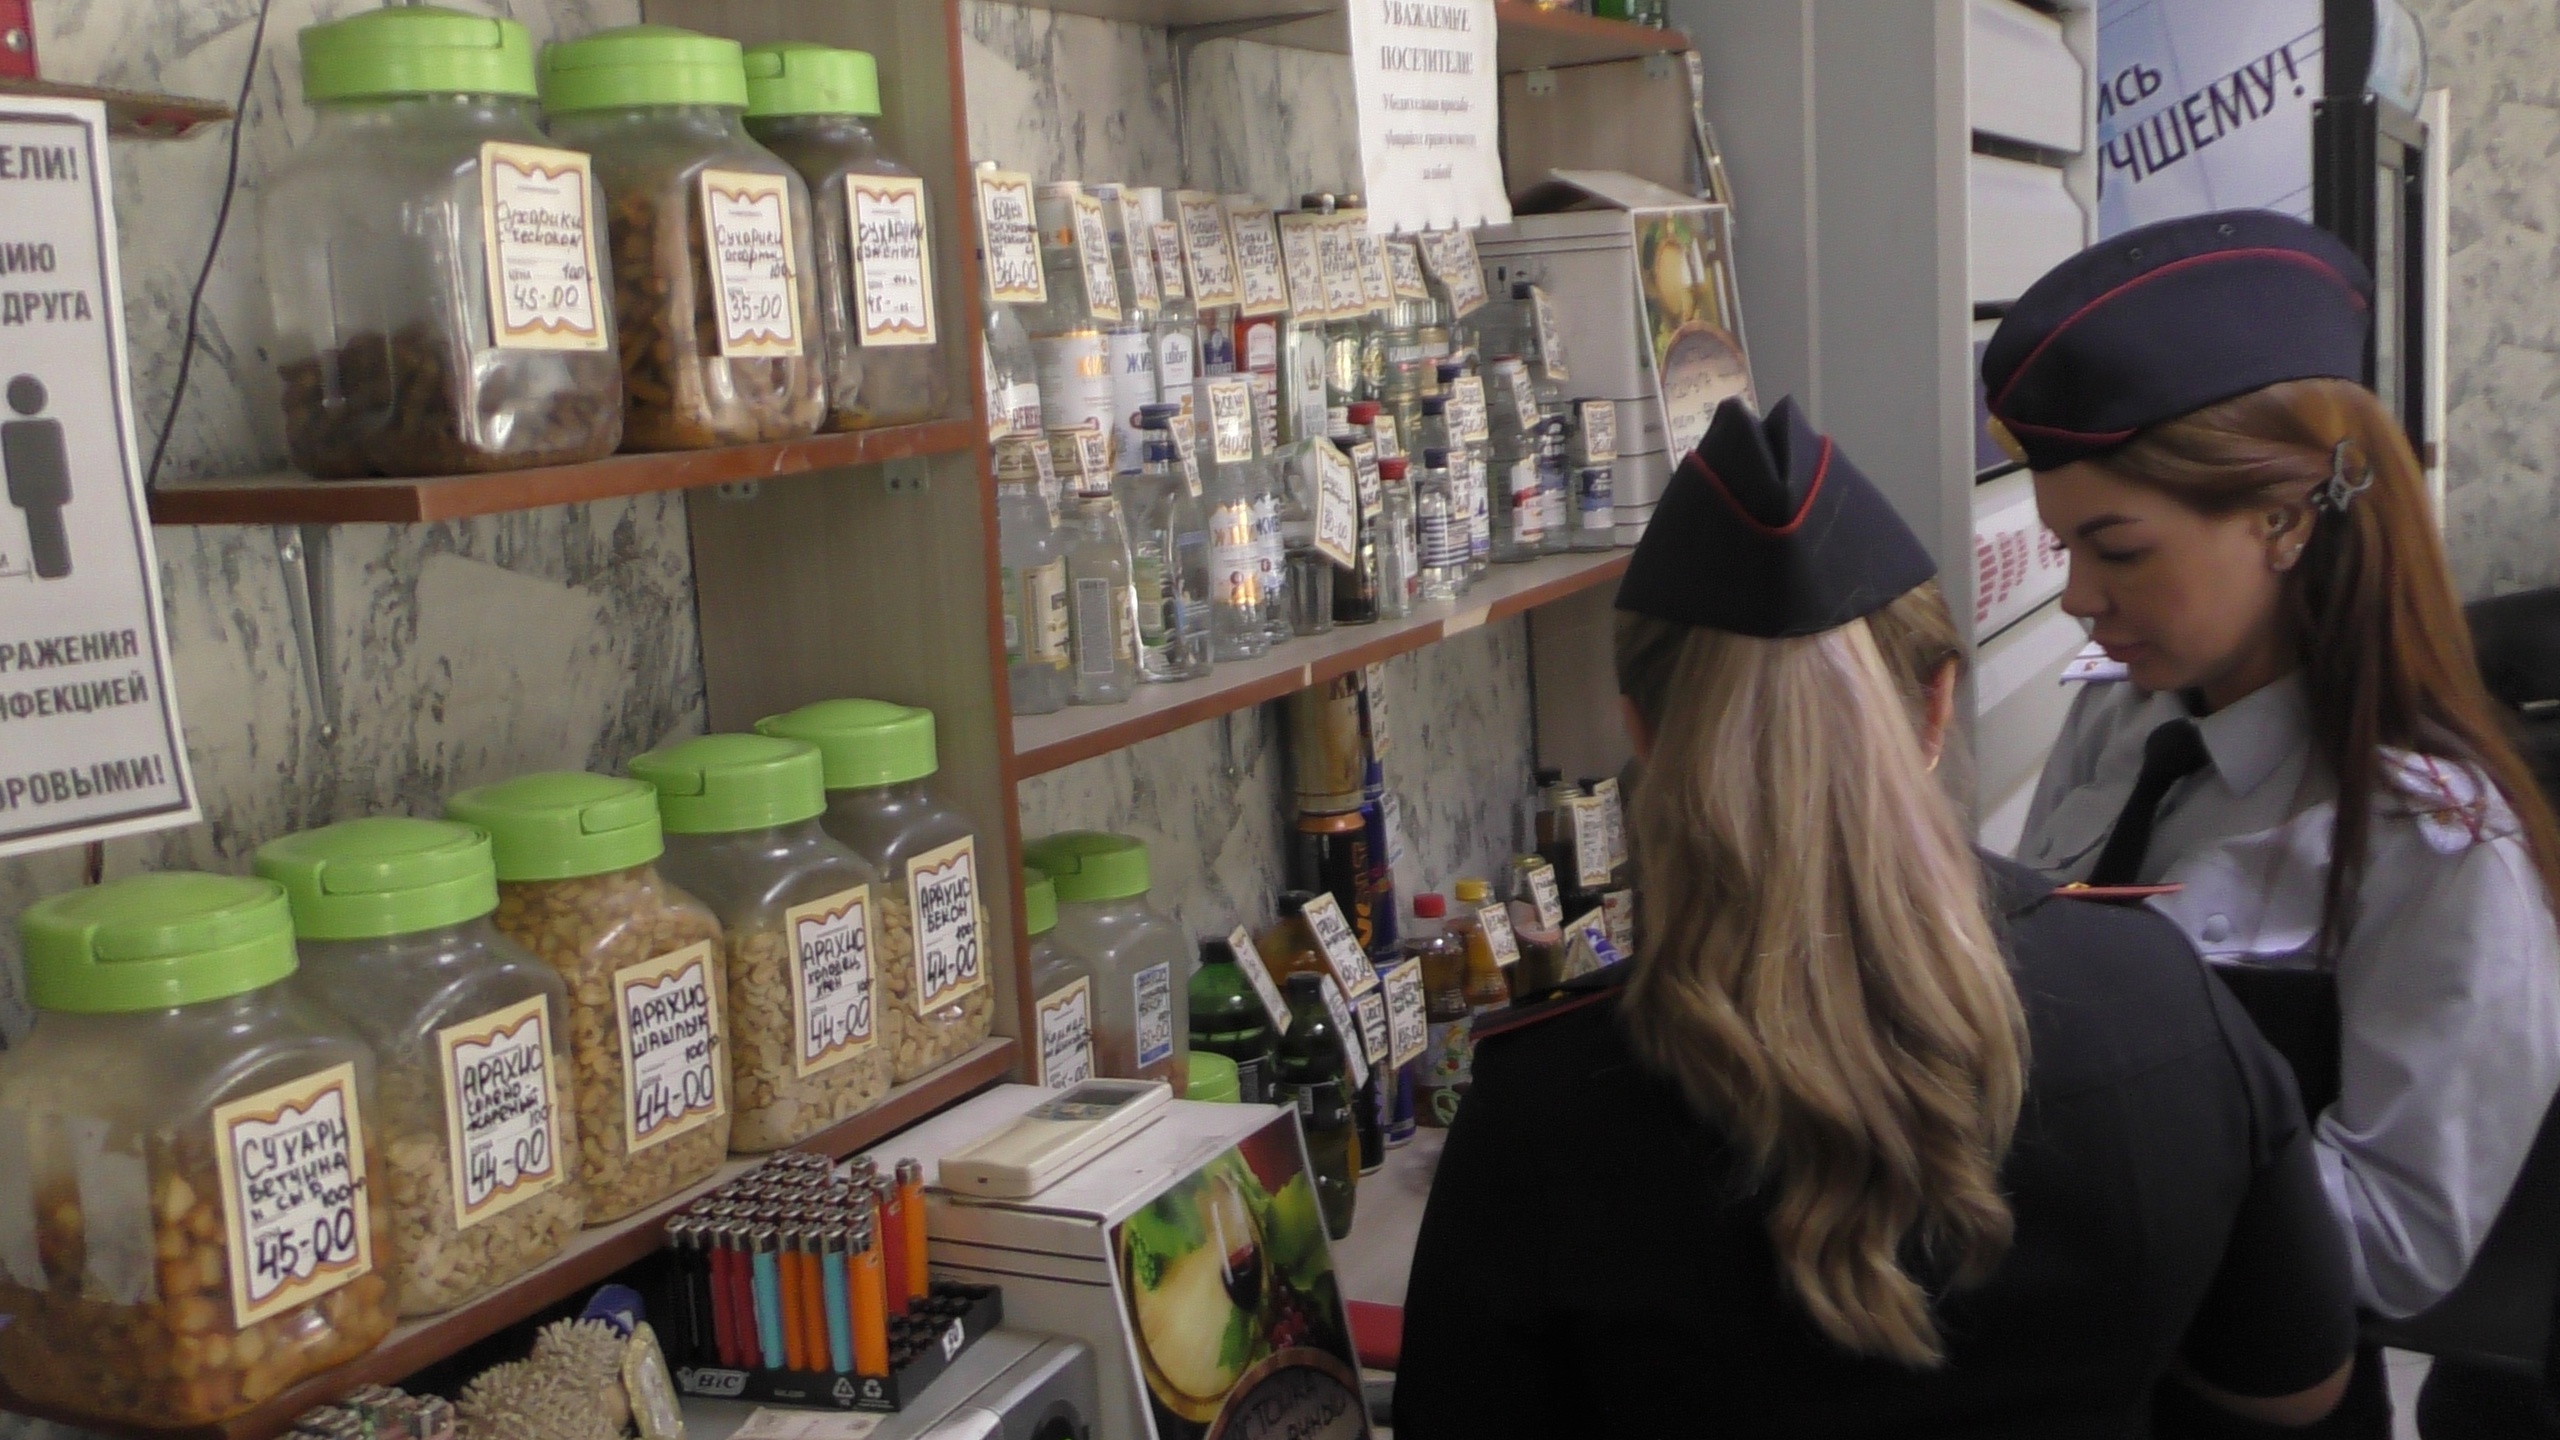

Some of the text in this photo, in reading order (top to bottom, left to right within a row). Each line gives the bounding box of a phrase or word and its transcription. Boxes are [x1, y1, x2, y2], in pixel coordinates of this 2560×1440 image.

[0, 145, 79, 182] ЕЛИ!
[0, 241, 57, 276] ИЮ
[2, 288, 93, 327] ДРУГА
[0, 628, 140, 673] РАЖЕНИЯ
[0, 753, 166, 812] РОВЫМИ!
[920, 876, 971, 918] АРАХИС
[802, 927, 866, 970] АРАХИС
[926, 938, 977, 992] 44-00
[632, 983, 710, 1035] АРАХИС
[810, 995, 871, 1050] 44-00
[463, 1044, 544, 1098] АРАХИС
[470, 1127, 546, 1193] 44-00
[256, 1207, 354, 1280] 45-00
